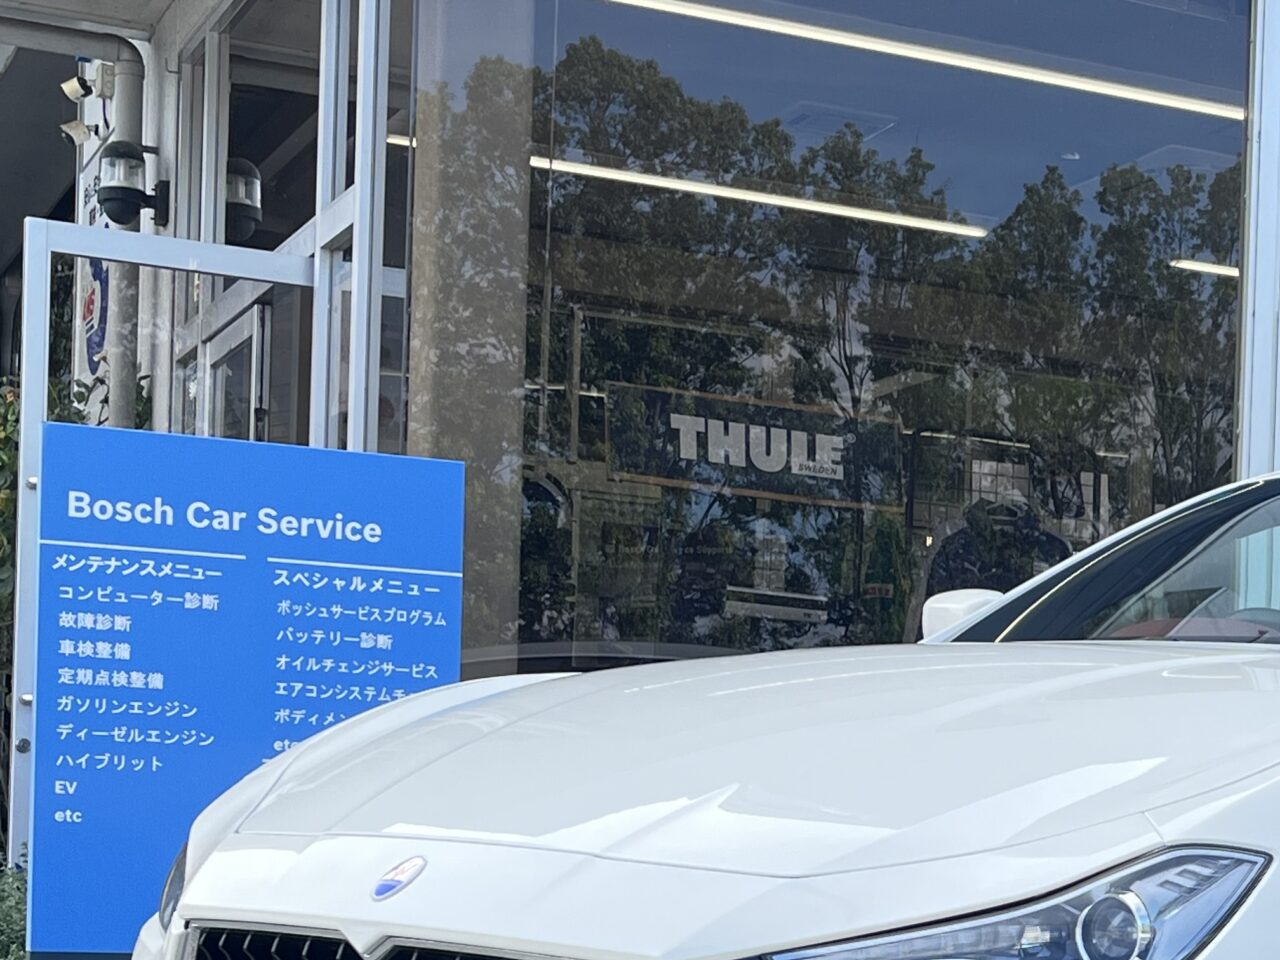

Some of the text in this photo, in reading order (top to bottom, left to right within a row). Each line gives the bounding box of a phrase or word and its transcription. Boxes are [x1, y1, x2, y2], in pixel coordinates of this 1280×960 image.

[670, 413, 844, 480] THULE
[68, 490, 382, 542] Bosch Car Service
[52, 553, 222, 580] メンテナンスメニュー
[273, 569, 440, 596] スペシャルメニュー
[59, 585, 220, 611] コンピューター診断
[58, 611, 132, 632] 故障診断
[277, 600, 447, 626] ボッシュサービスプログラム
[58, 639, 131, 660] 車検整備
[276, 627, 393, 650] バッテリー診断
[275, 654, 438, 679] オイルチェンジサービス
[57, 667, 164, 690] 定期点検整備
[274, 682, 414, 702] エアコンシステムチ
[56, 695, 198, 718] ガソリンエンジン
[274, 708, 346, 725] ボディメ
[56, 723, 214, 746] ディーゼルエンジン
[54, 780, 77, 794] EV
[54, 809, 82, 822] etc
